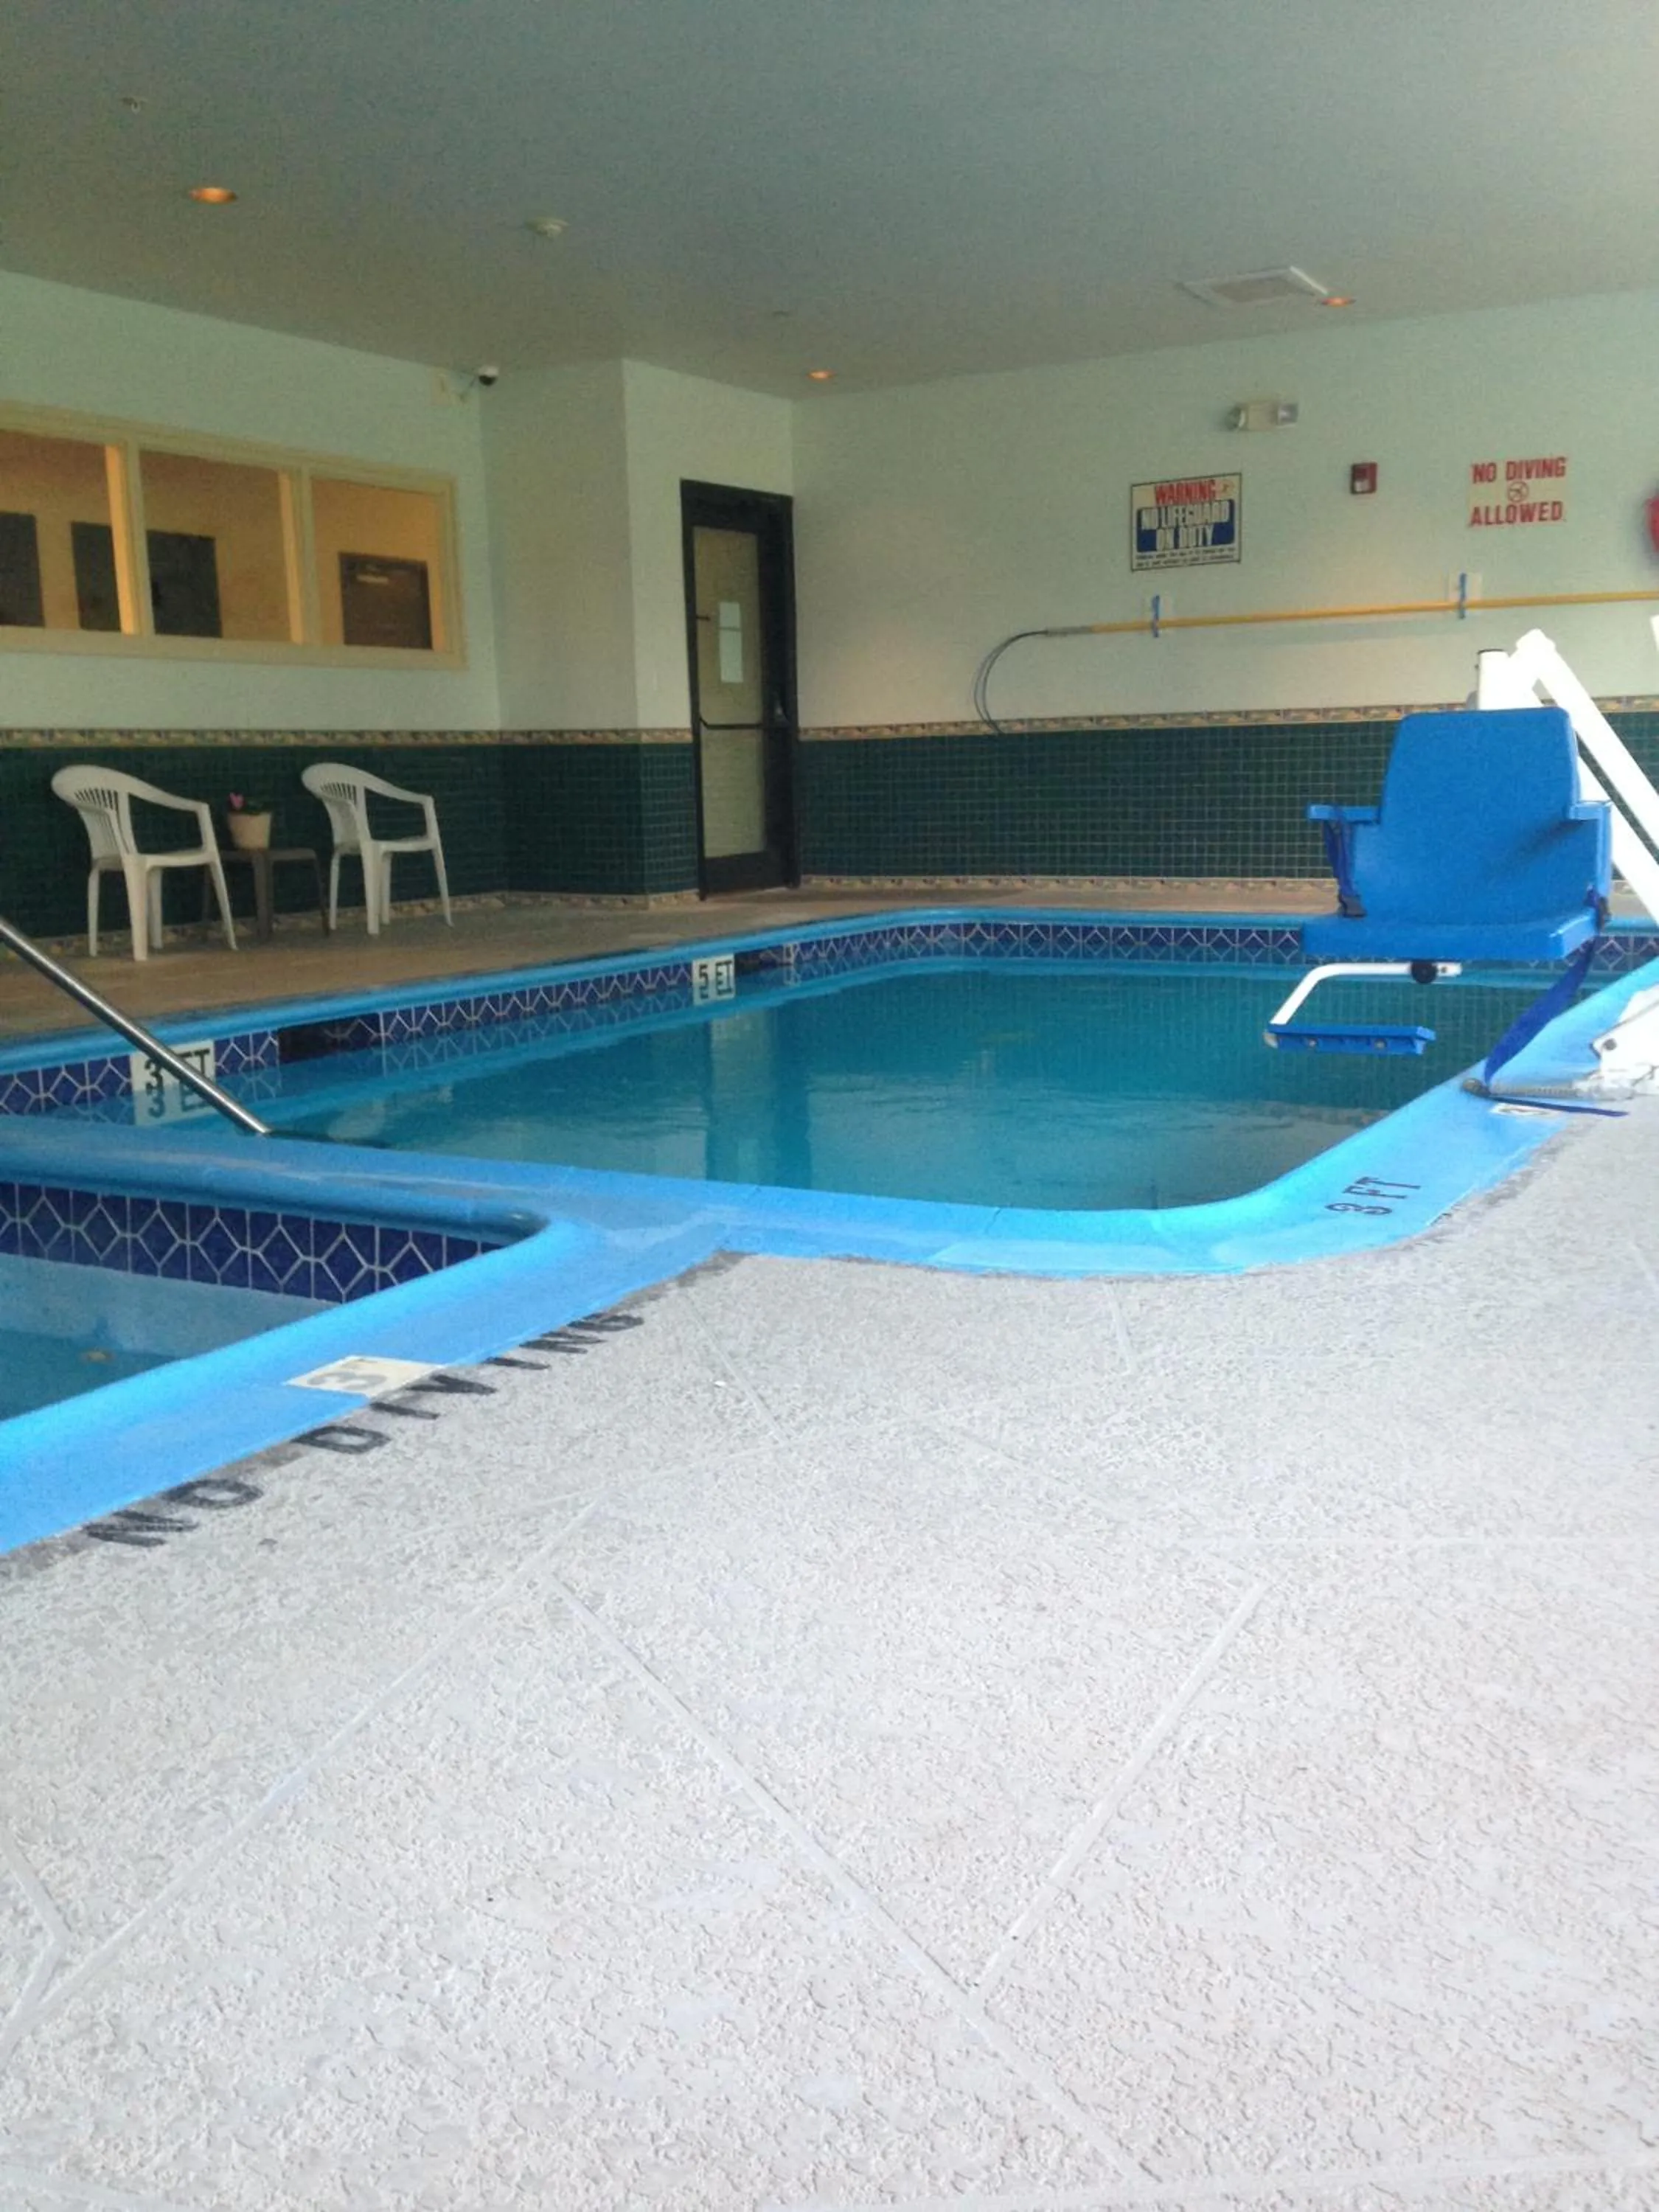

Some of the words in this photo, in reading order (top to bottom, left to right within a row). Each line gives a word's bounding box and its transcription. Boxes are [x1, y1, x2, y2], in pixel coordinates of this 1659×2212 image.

[1470, 462, 1497, 484] NO
[1506, 456, 1567, 481] DIVING
[1155, 479, 1216, 505] WARNING
[1469, 501, 1563, 526] ALLOWED
[83, 1478, 264, 1547] NO
[291, 1312, 645, 1454] DIVING
